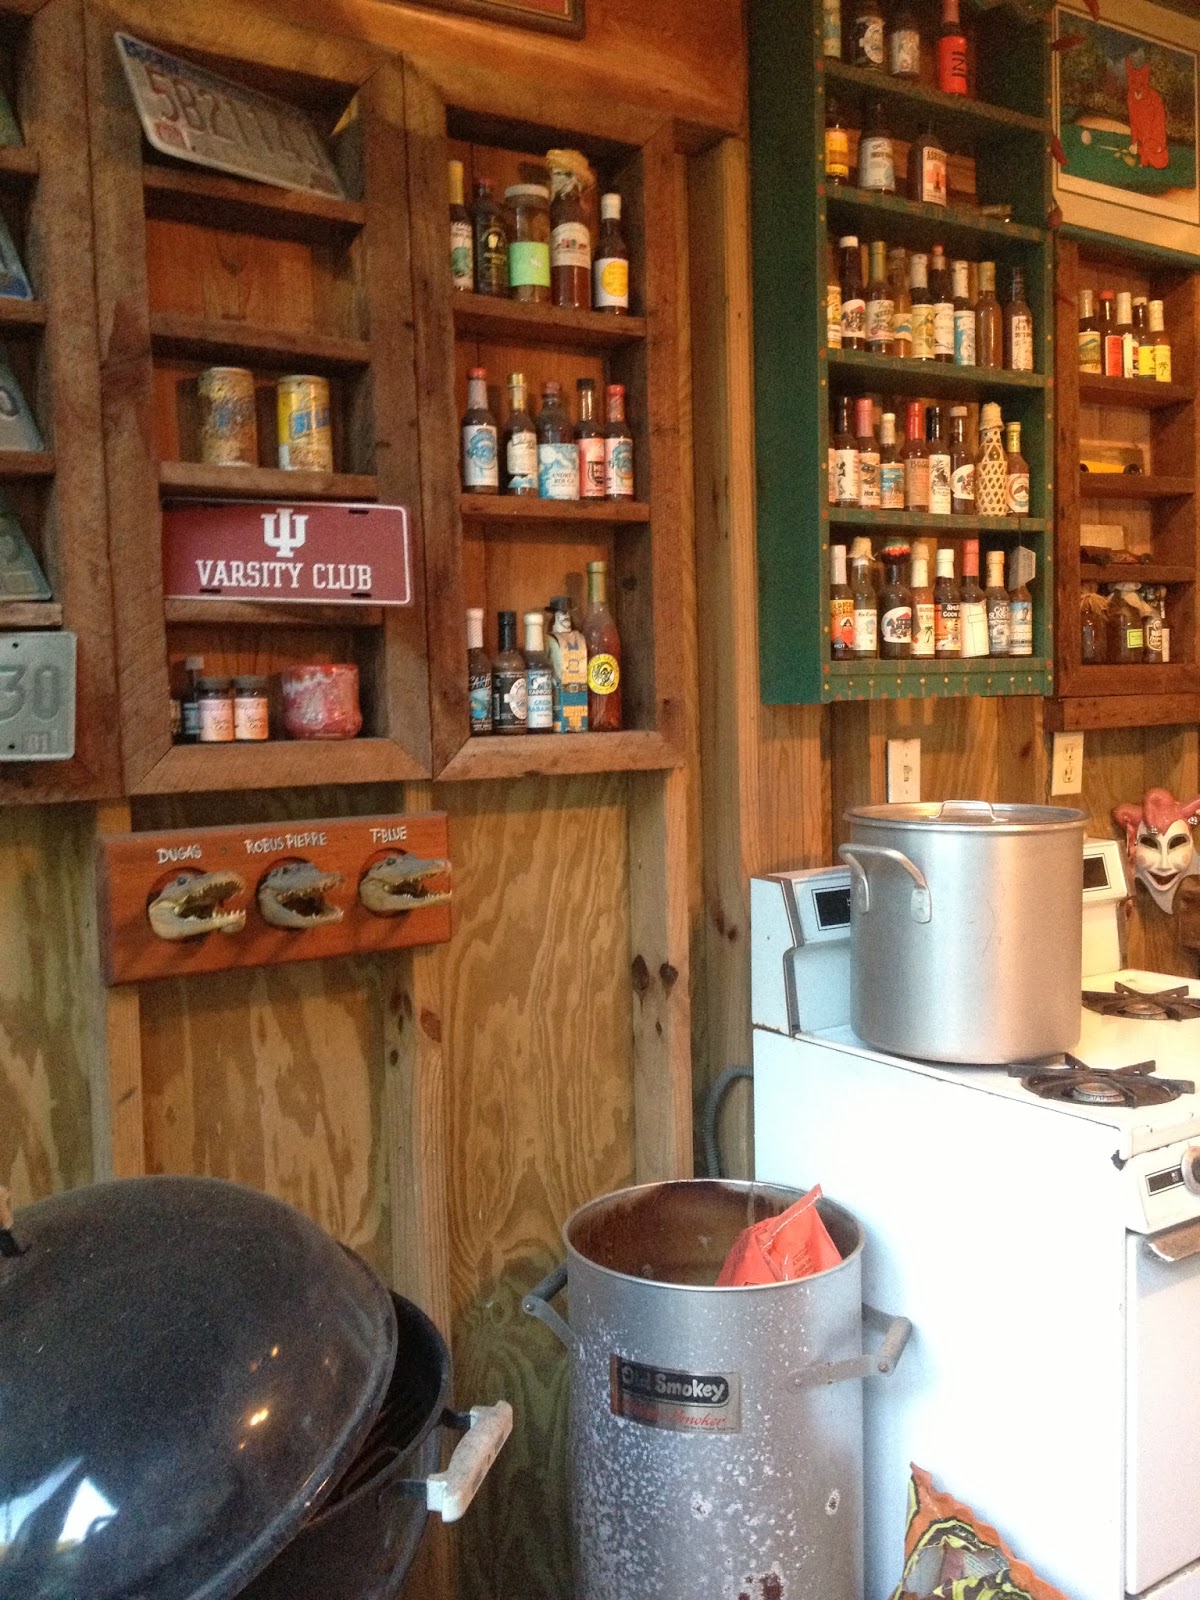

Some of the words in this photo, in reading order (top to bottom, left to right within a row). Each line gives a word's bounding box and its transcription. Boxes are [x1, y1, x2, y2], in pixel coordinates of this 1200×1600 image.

[195, 559, 304, 588] VARSITY
[312, 563, 373, 590] CLUB
[285, 832, 327, 849] PIERRE
[156, 844, 202, 864] DUGAS
[654, 1373, 725, 1402] Smokey
